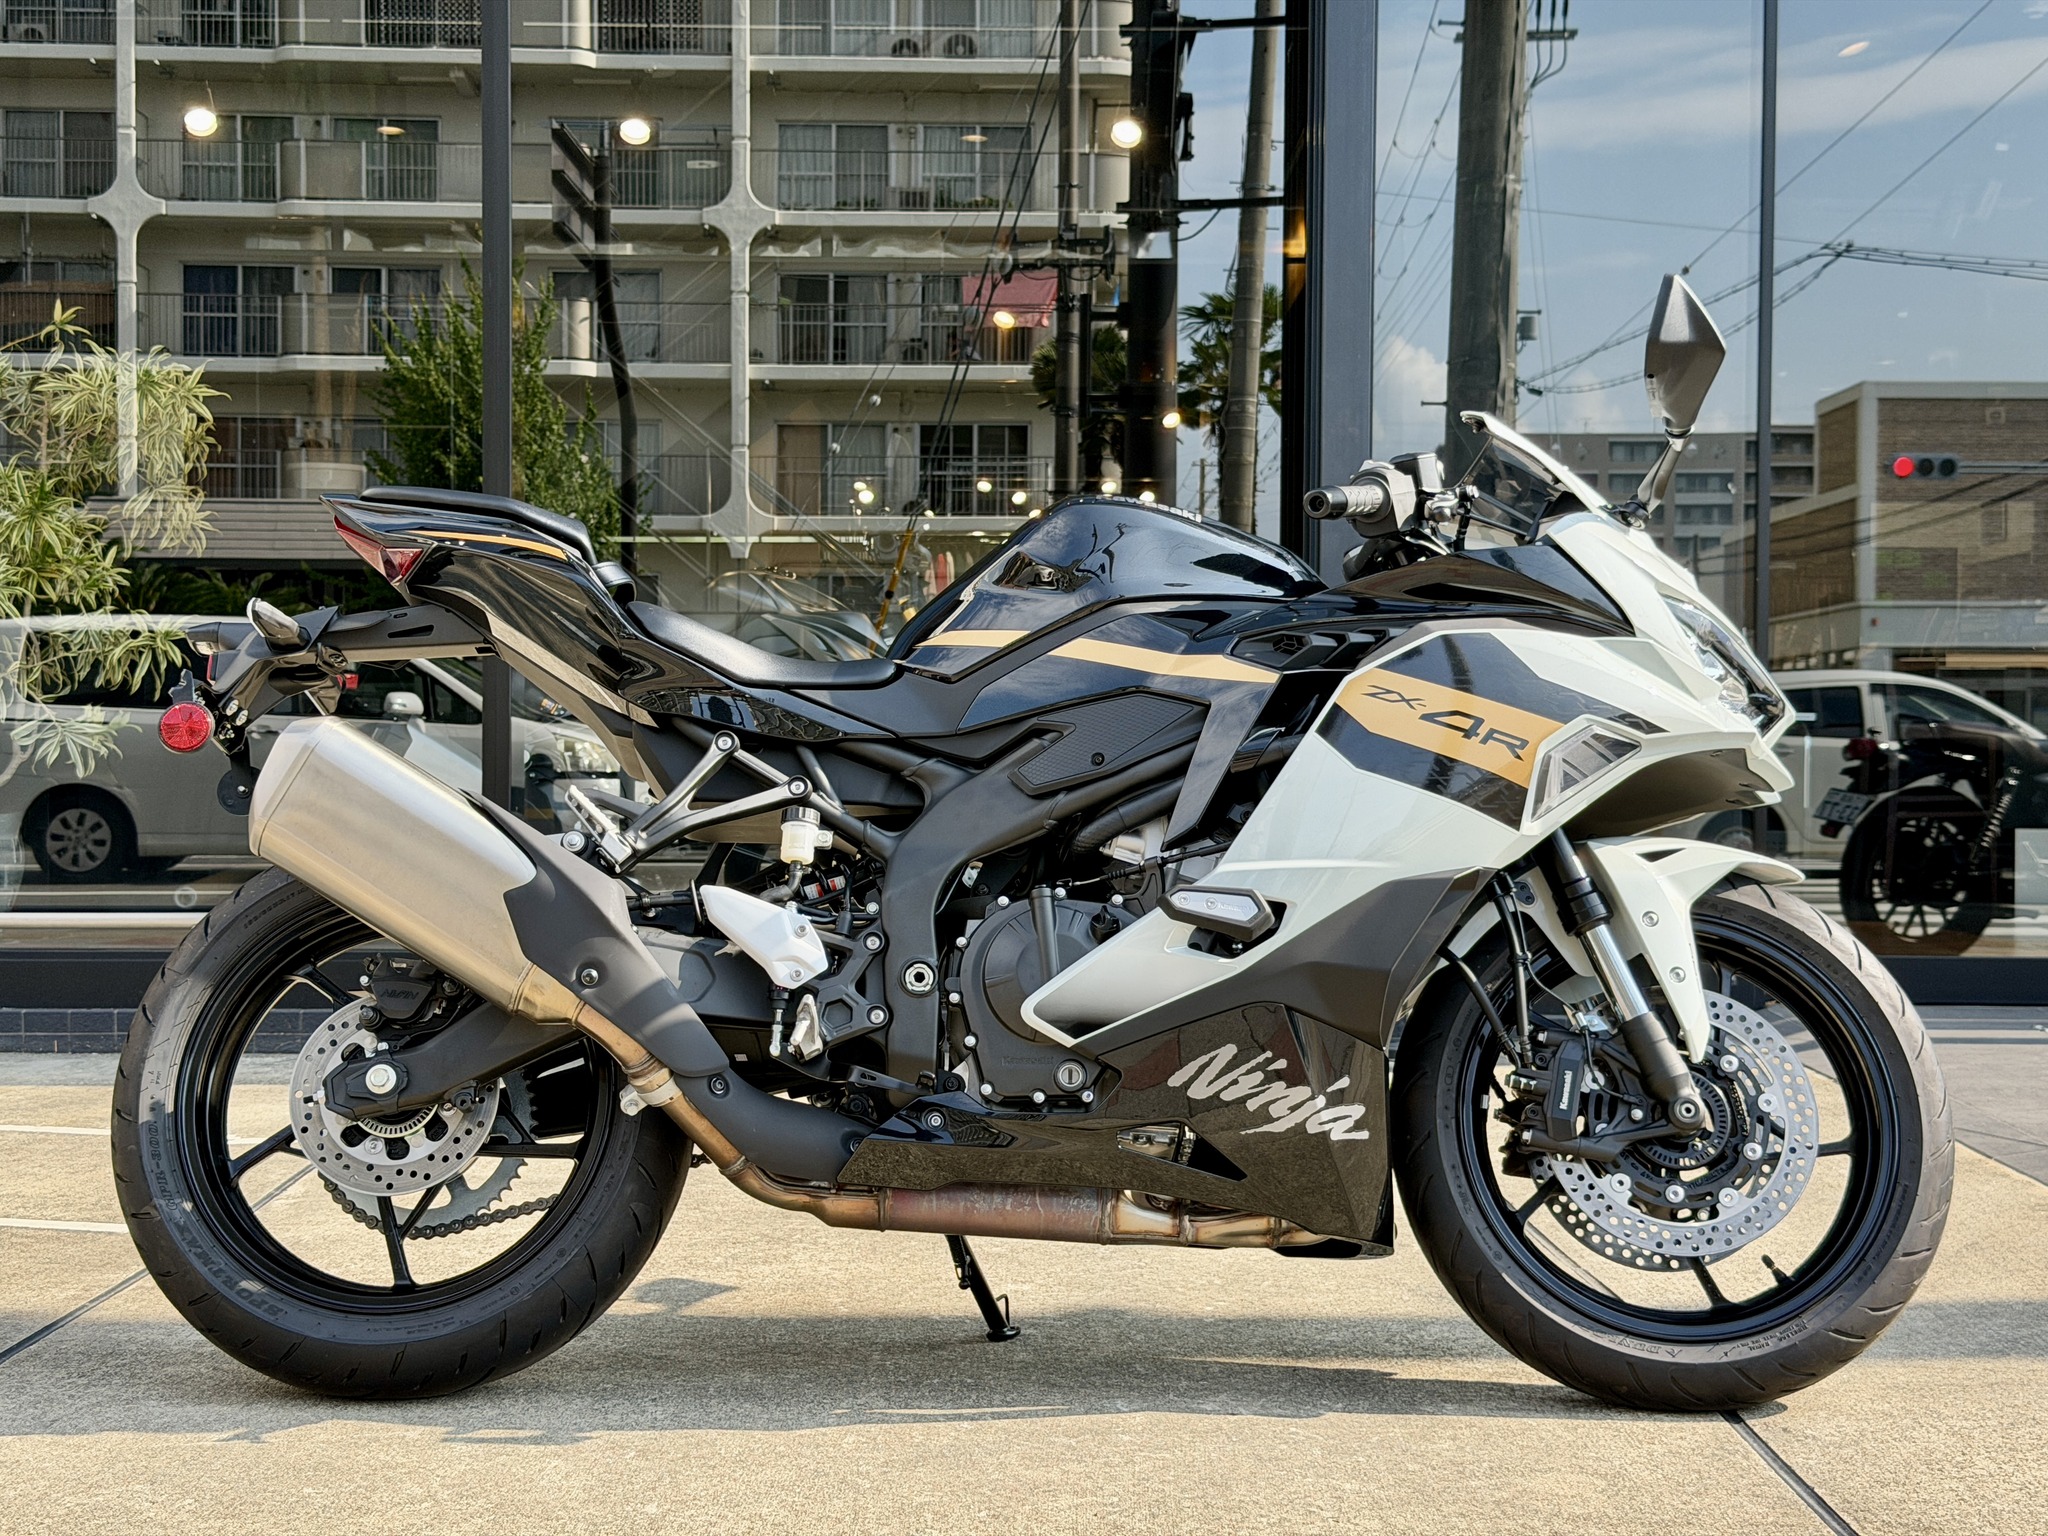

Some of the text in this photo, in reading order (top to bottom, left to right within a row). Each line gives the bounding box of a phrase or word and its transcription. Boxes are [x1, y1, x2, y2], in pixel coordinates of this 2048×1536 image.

[1361, 684, 1530, 762] ZX-4R
[1167, 1043, 1370, 1140] Ninja
[1559, 1070, 1573, 1110] Kawasaki
